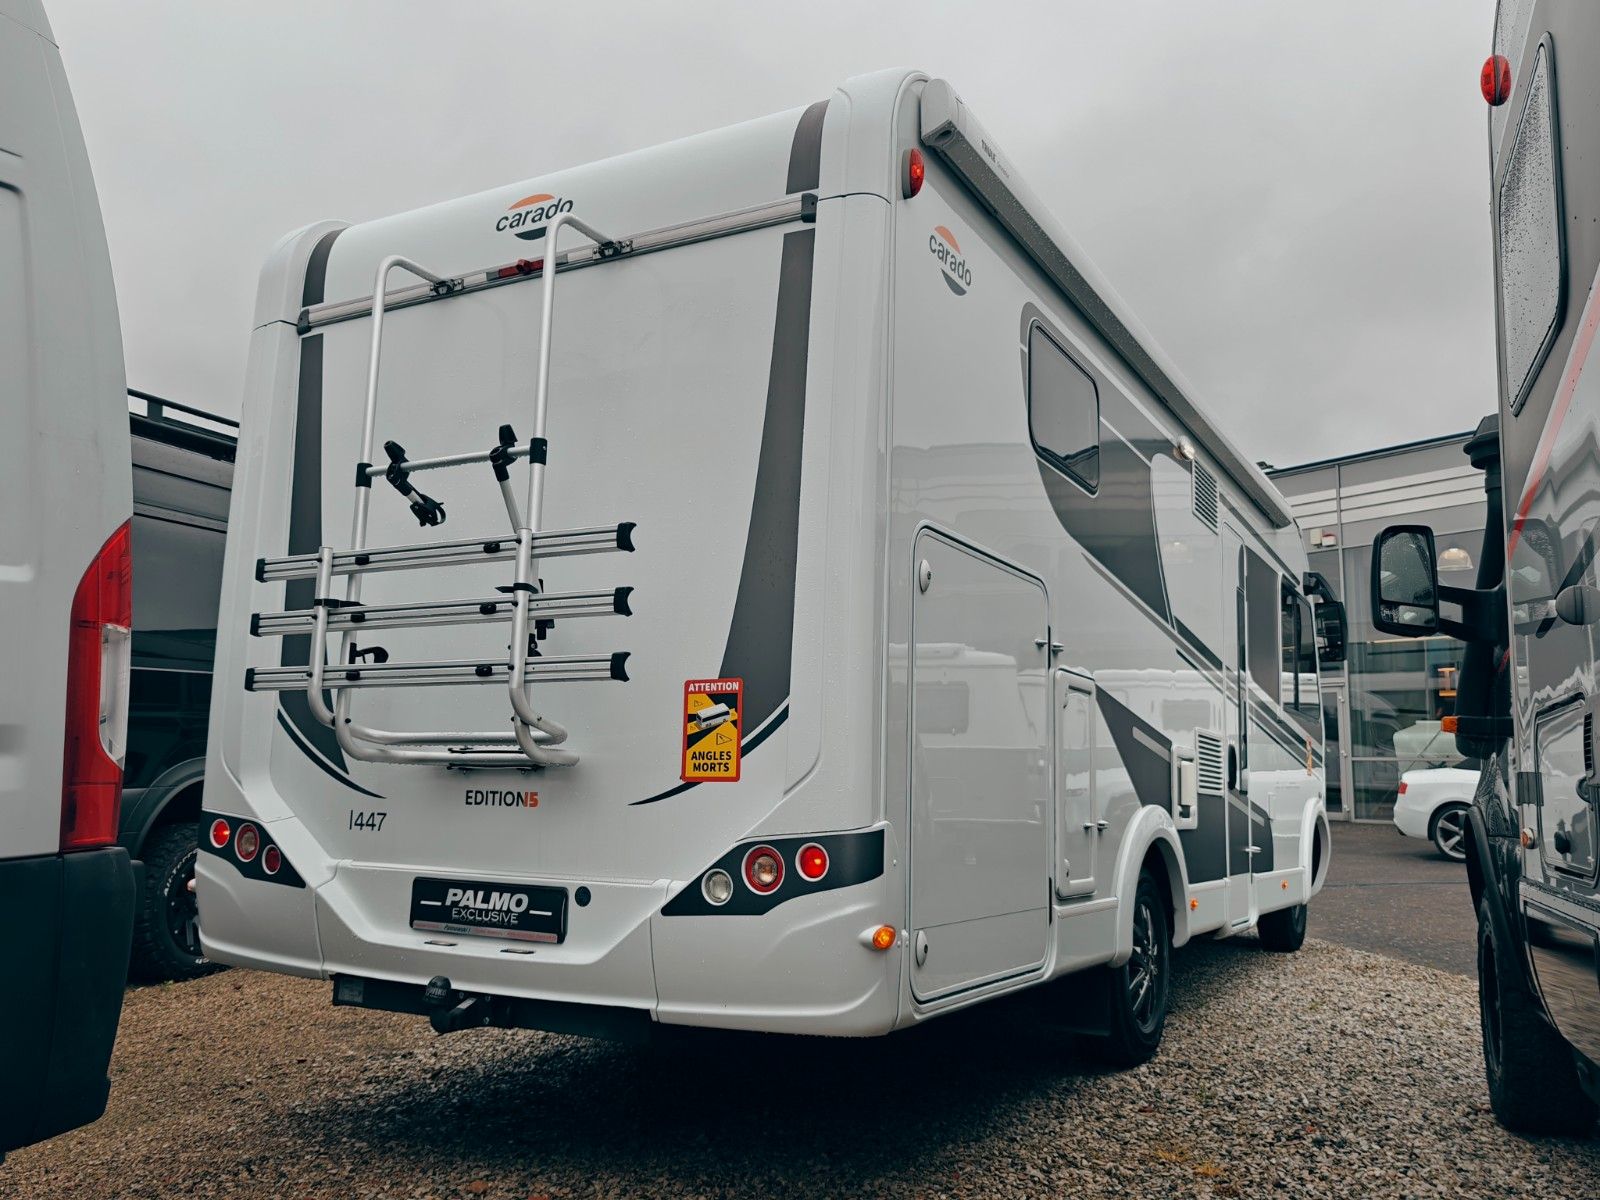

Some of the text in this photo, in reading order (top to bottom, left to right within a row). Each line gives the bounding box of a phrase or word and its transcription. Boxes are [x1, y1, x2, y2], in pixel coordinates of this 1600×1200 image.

[495, 197, 574, 232] carado
[929, 234, 972, 286] carado
[688, 681, 739, 692] ATTENTION
[691, 751, 732, 761] ANGLES
[693, 762, 730, 772] MORTS
[445, 888, 529, 913] PALMO
[452, 907, 518, 923] EXCLUSIVE
